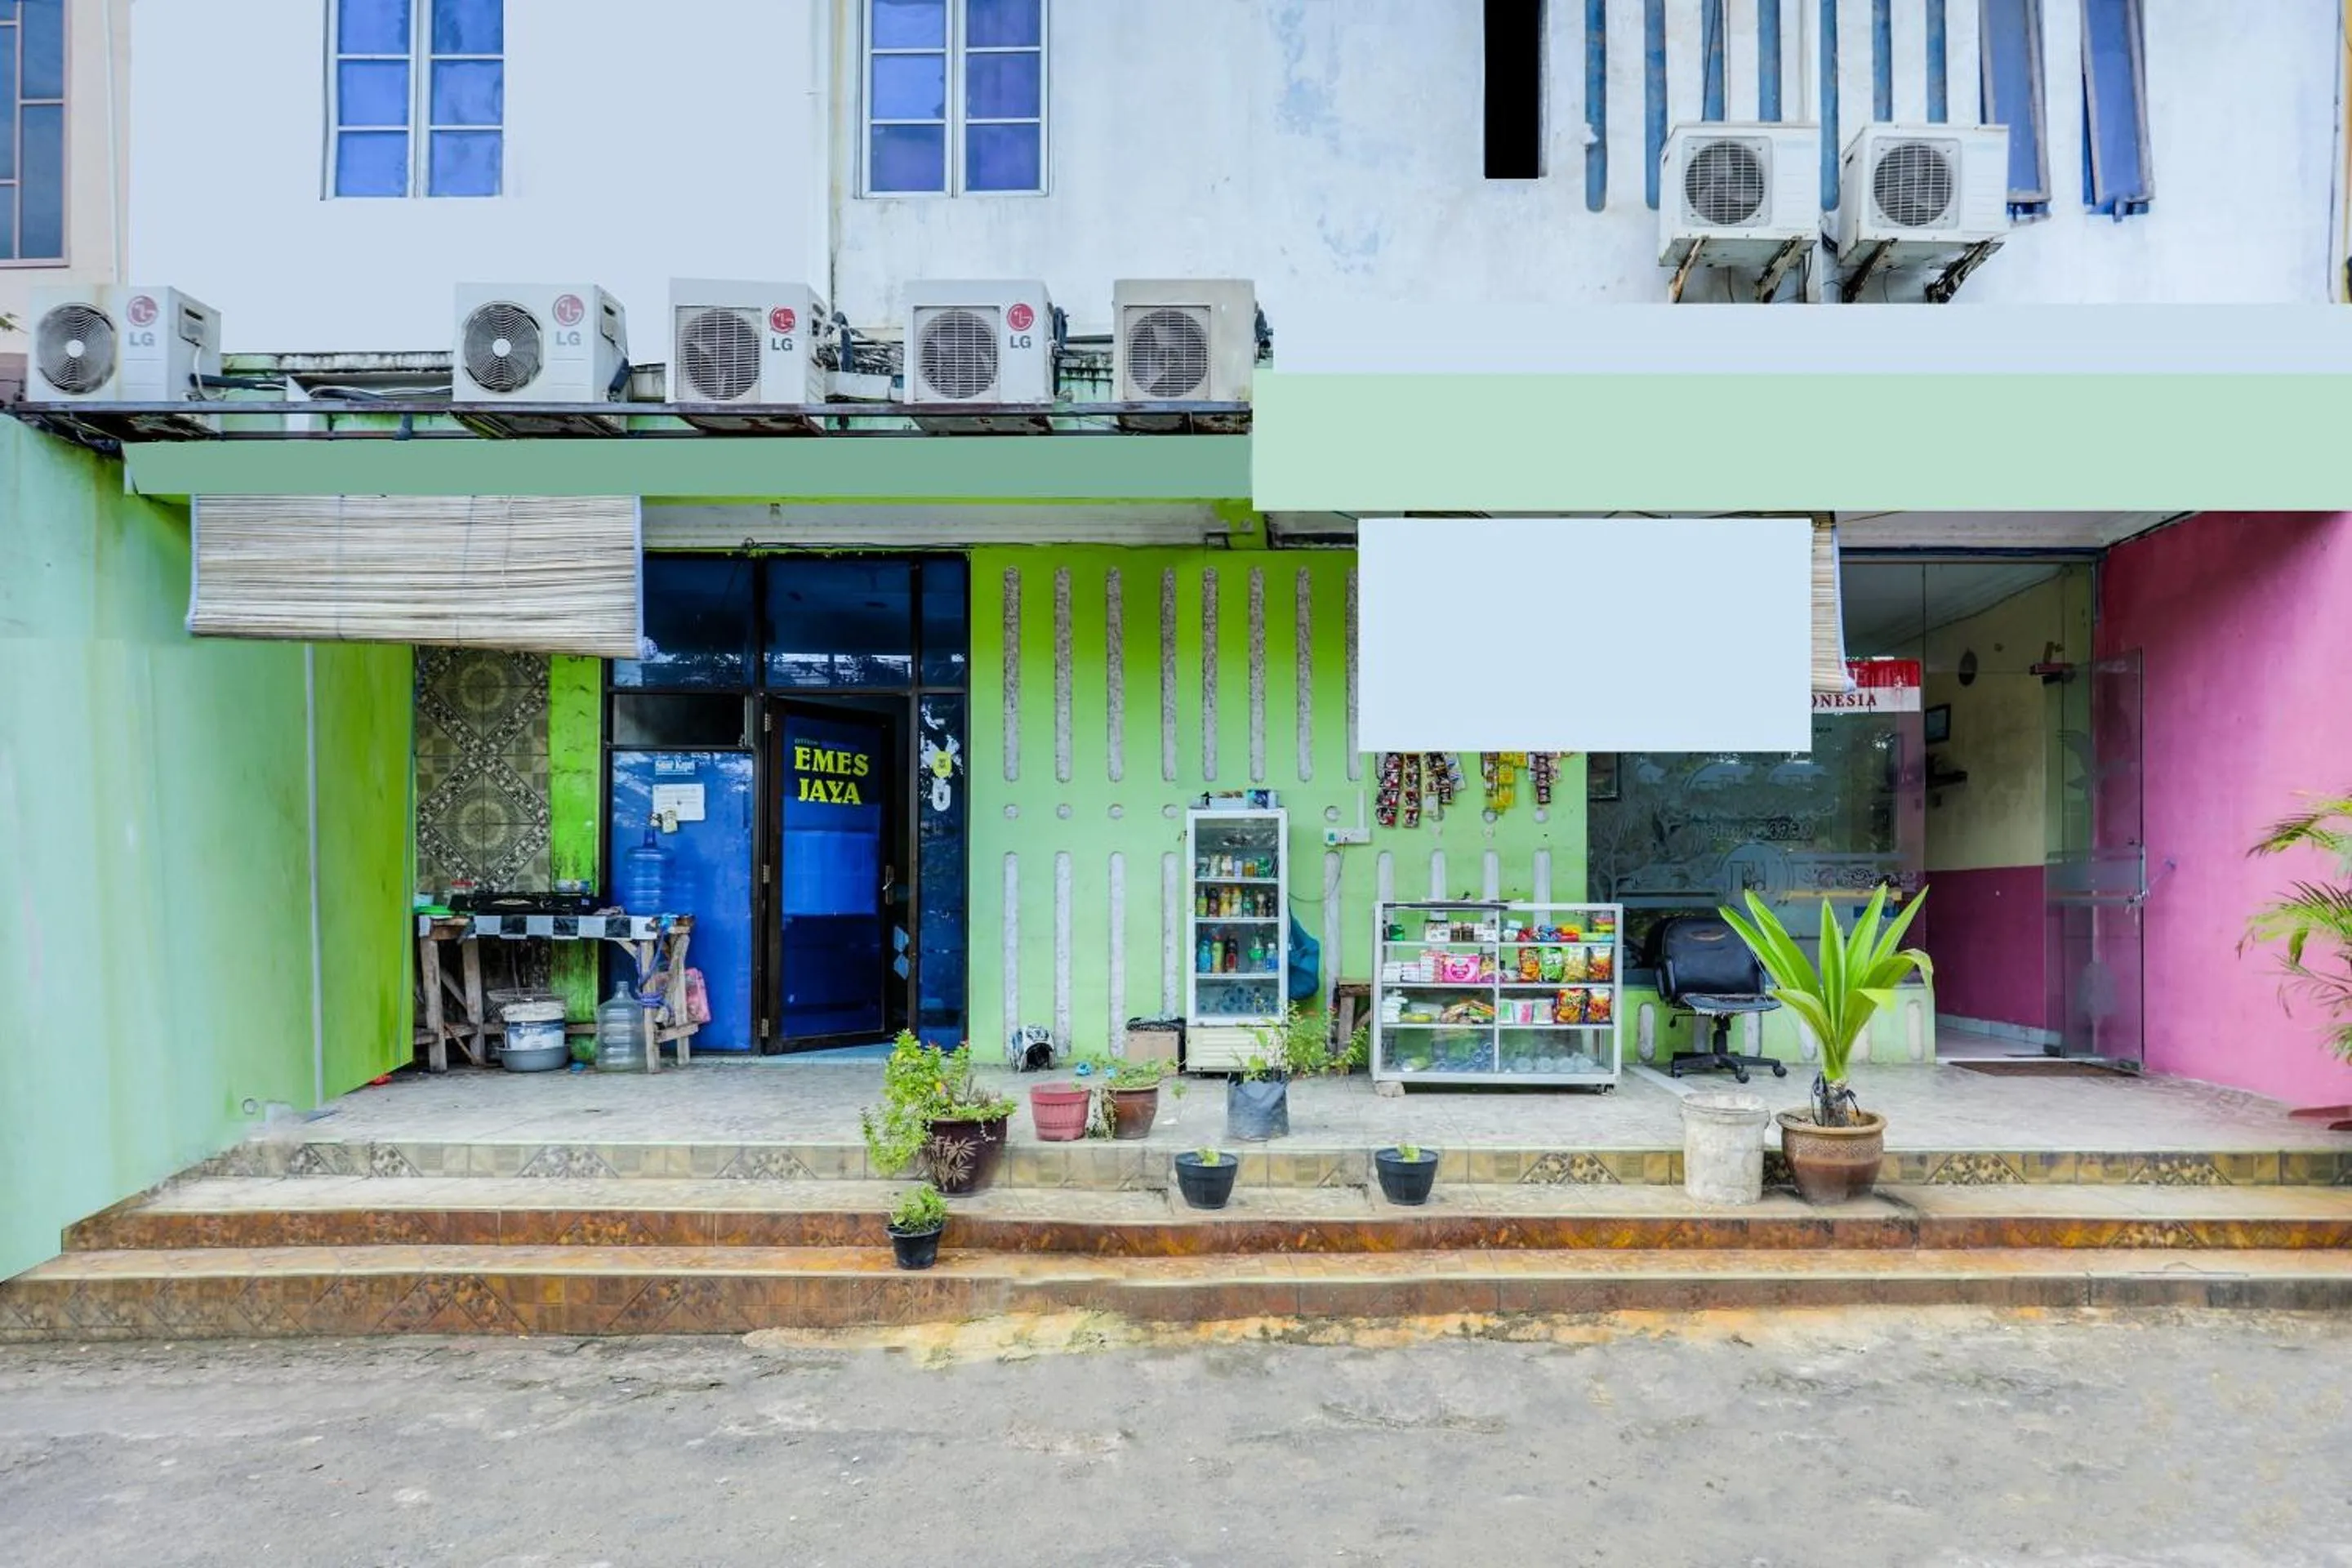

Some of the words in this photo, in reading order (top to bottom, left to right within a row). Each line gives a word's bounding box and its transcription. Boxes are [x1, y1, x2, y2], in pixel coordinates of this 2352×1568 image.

[128, 331, 155, 346] LG
[555, 331, 581, 345] LG
[771, 337, 793, 351] LG
[1009, 334, 1031, 349] LG
[794, 746, 870, 777] EMES
[797, 777, 862, 805] JAYA
